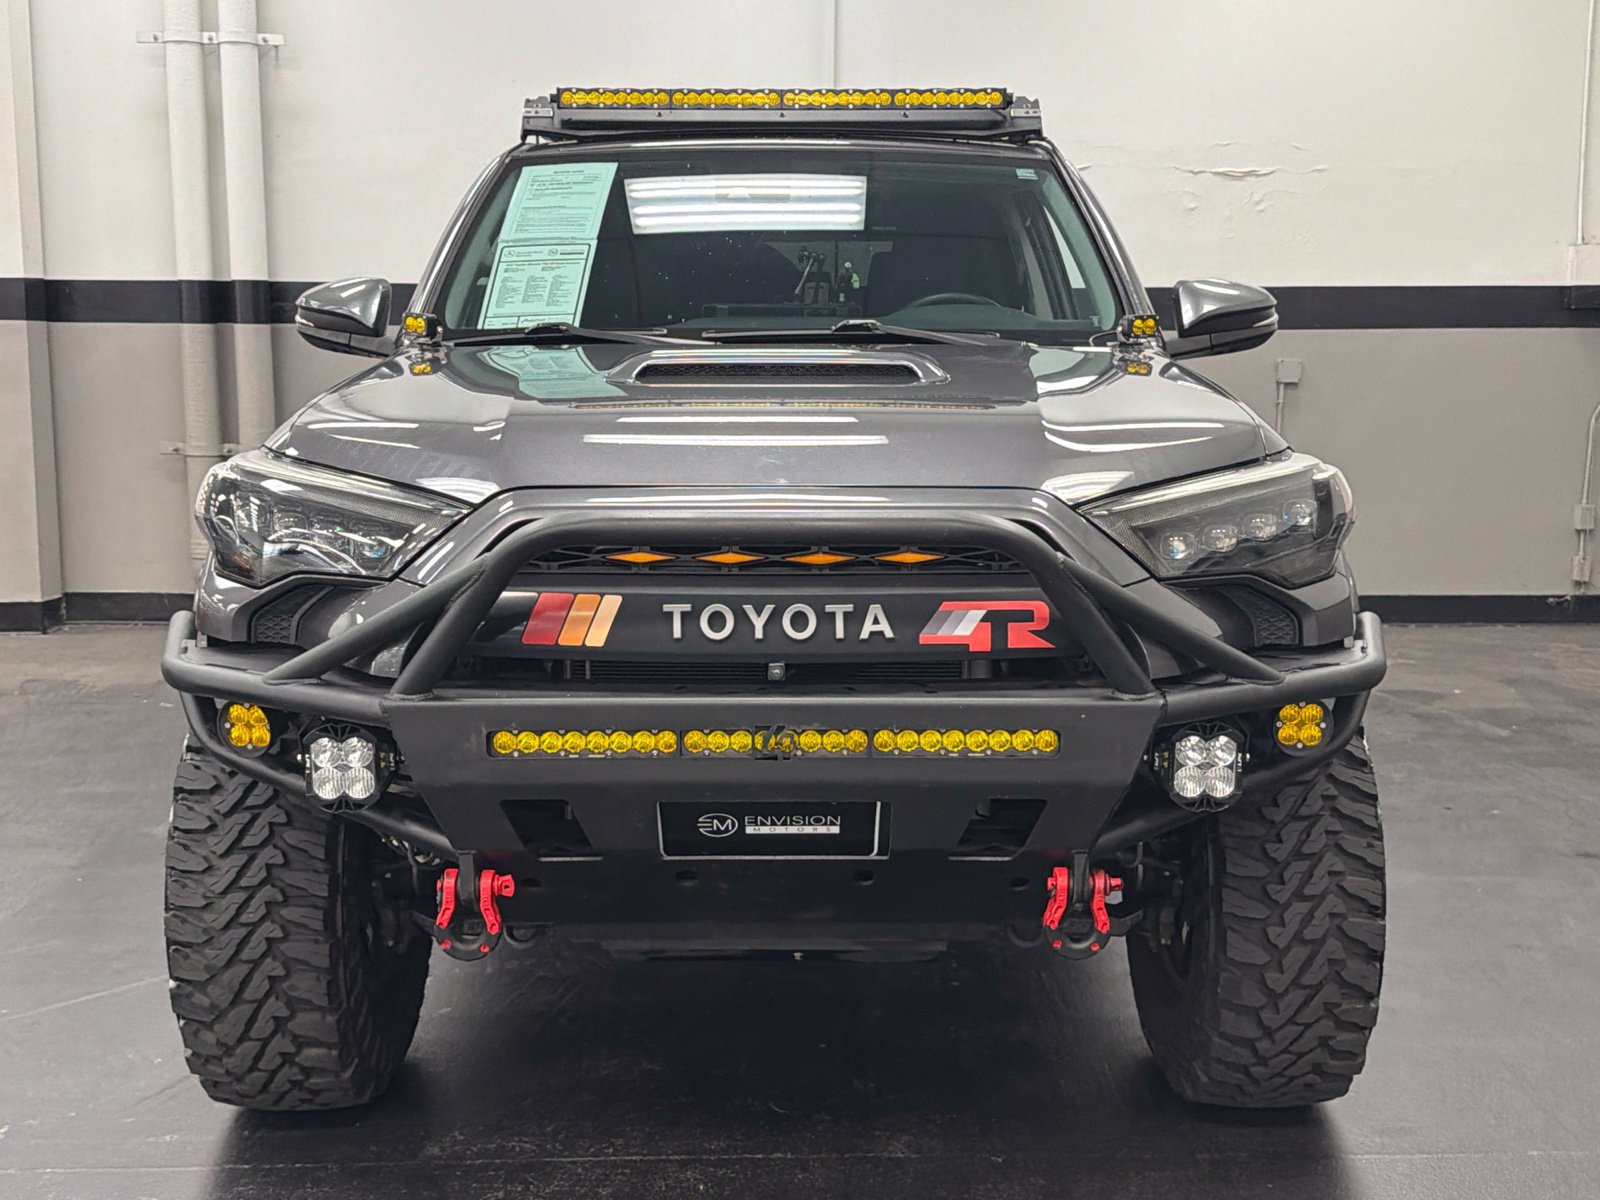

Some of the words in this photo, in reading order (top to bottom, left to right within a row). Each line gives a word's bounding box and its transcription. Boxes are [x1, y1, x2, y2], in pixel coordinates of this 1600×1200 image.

[662, 603, 895, 641] TOYOTA
[918, 600, 1056, 652] 4R
[744, 815, 841, 826] ENVISION
